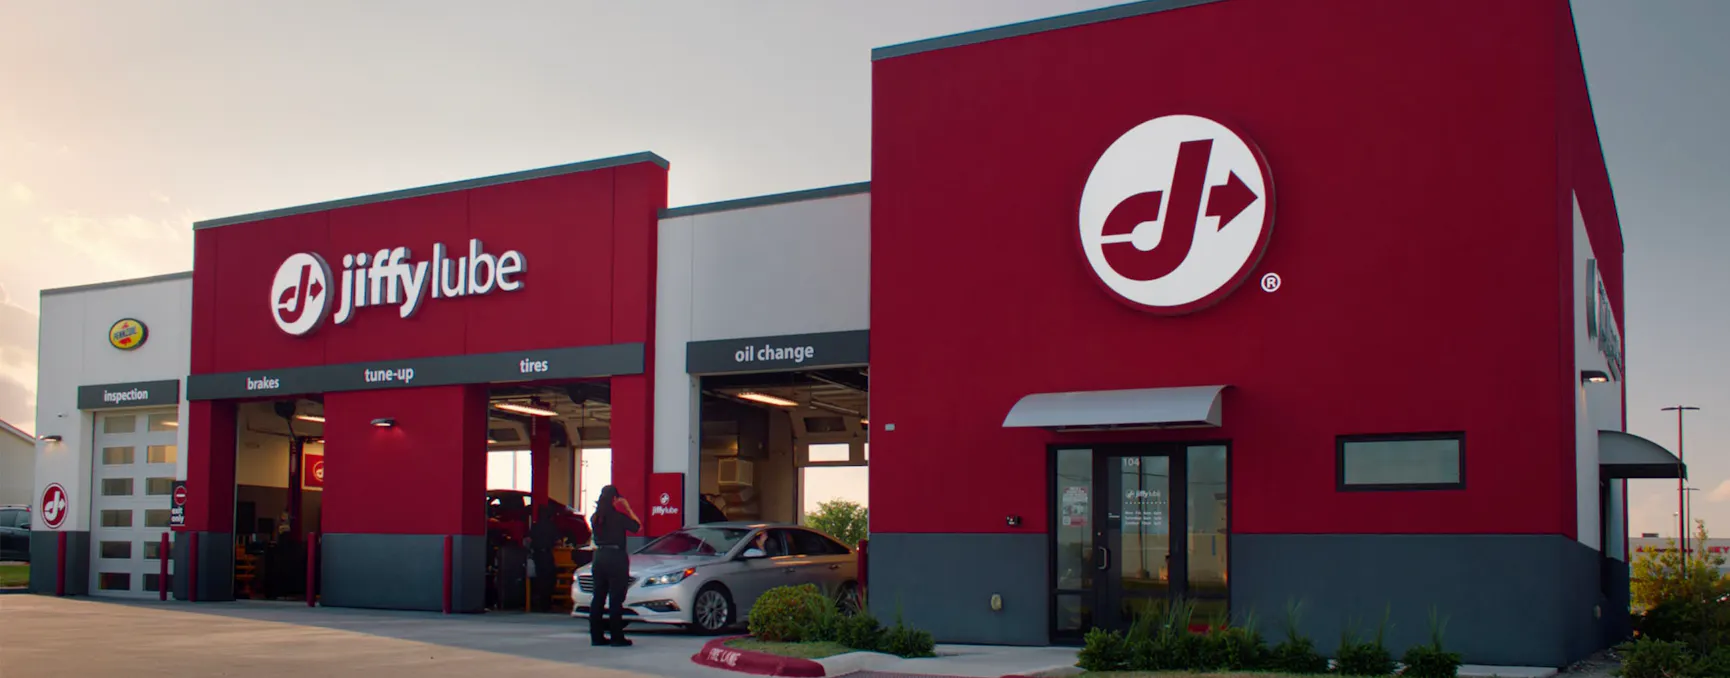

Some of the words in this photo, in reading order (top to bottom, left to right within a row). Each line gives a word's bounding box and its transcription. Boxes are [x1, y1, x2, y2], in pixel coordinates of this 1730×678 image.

[735, 345, 754, 363] oil
[757, 344, 815, 363] change
[519, 358, 549, 373] tires
[364, 367, 415, 383] tune-up
[247, 376, 280, 390] brakes
[104, 388, 149, 405] inspection
[1122, 457, 1140, 467] 104
[171, 505, 184, 514] exit
[171, 514, 185, 524] only
